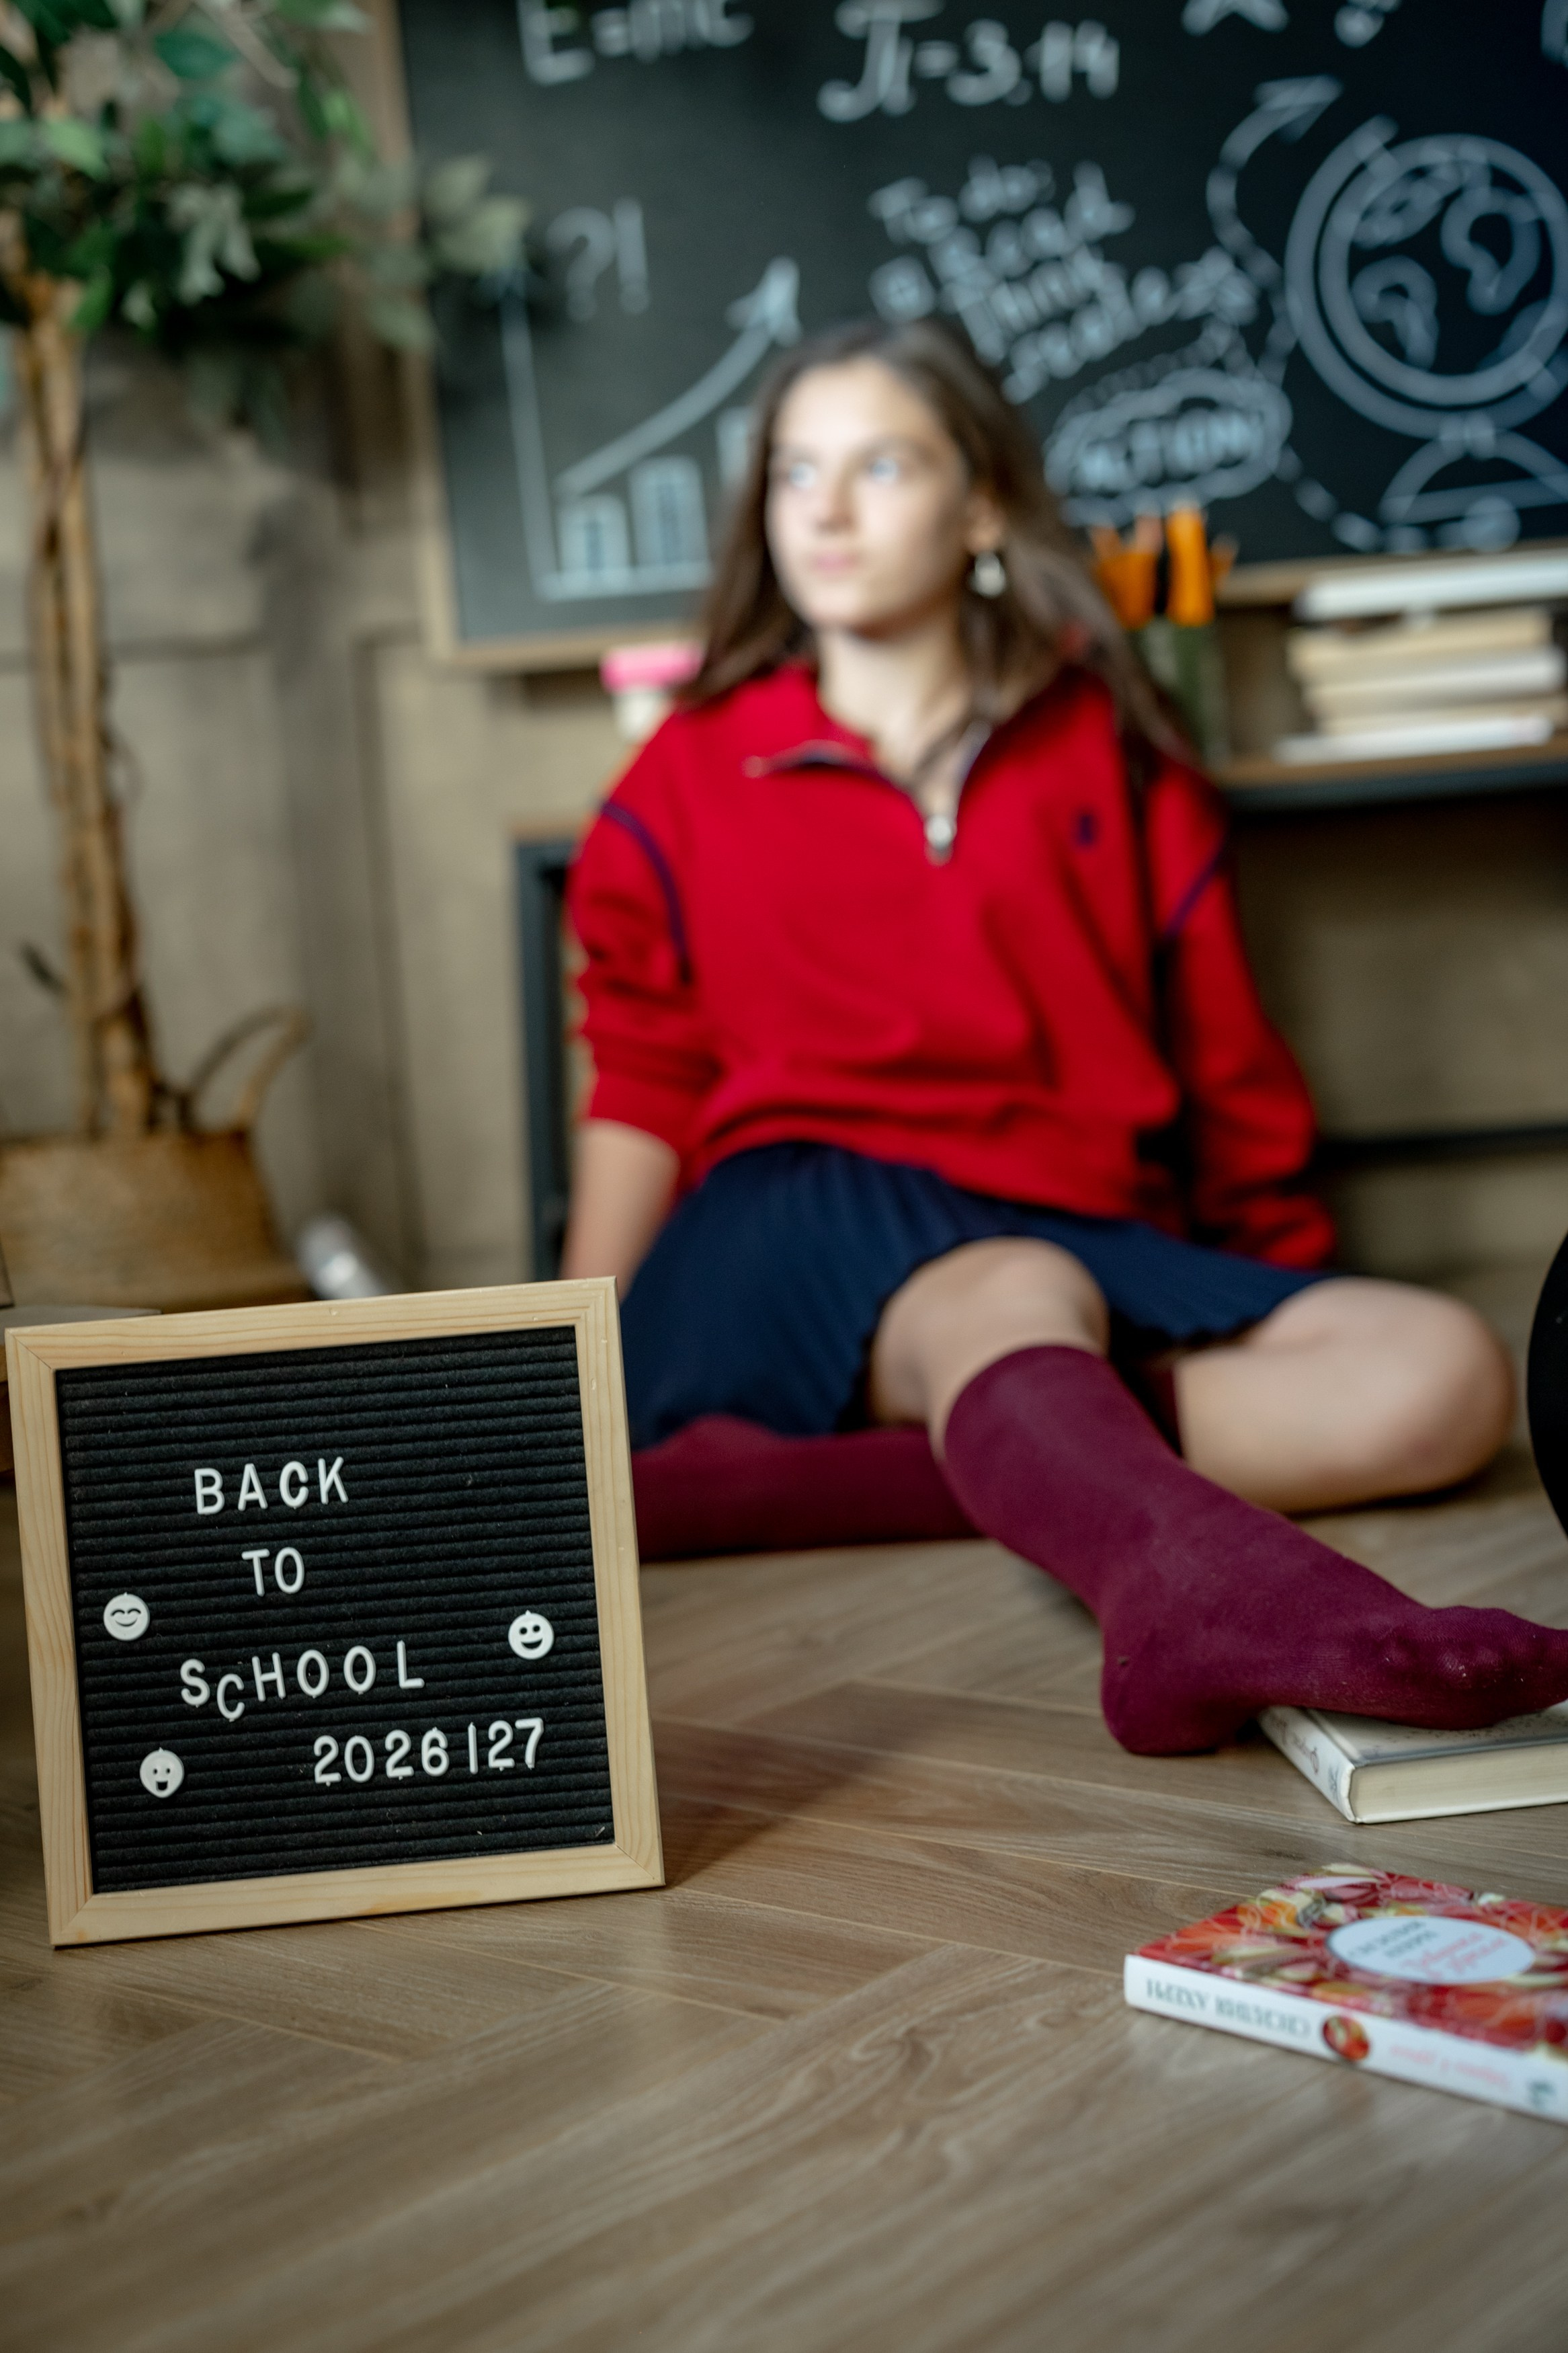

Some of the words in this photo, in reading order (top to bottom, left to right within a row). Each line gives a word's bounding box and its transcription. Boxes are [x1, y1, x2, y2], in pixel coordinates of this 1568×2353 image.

[194, 1456, 348, 1515] BACK
[241, 1547, 305, 1596] TO
[179, 1640, 425, 1722] SCHOOL
